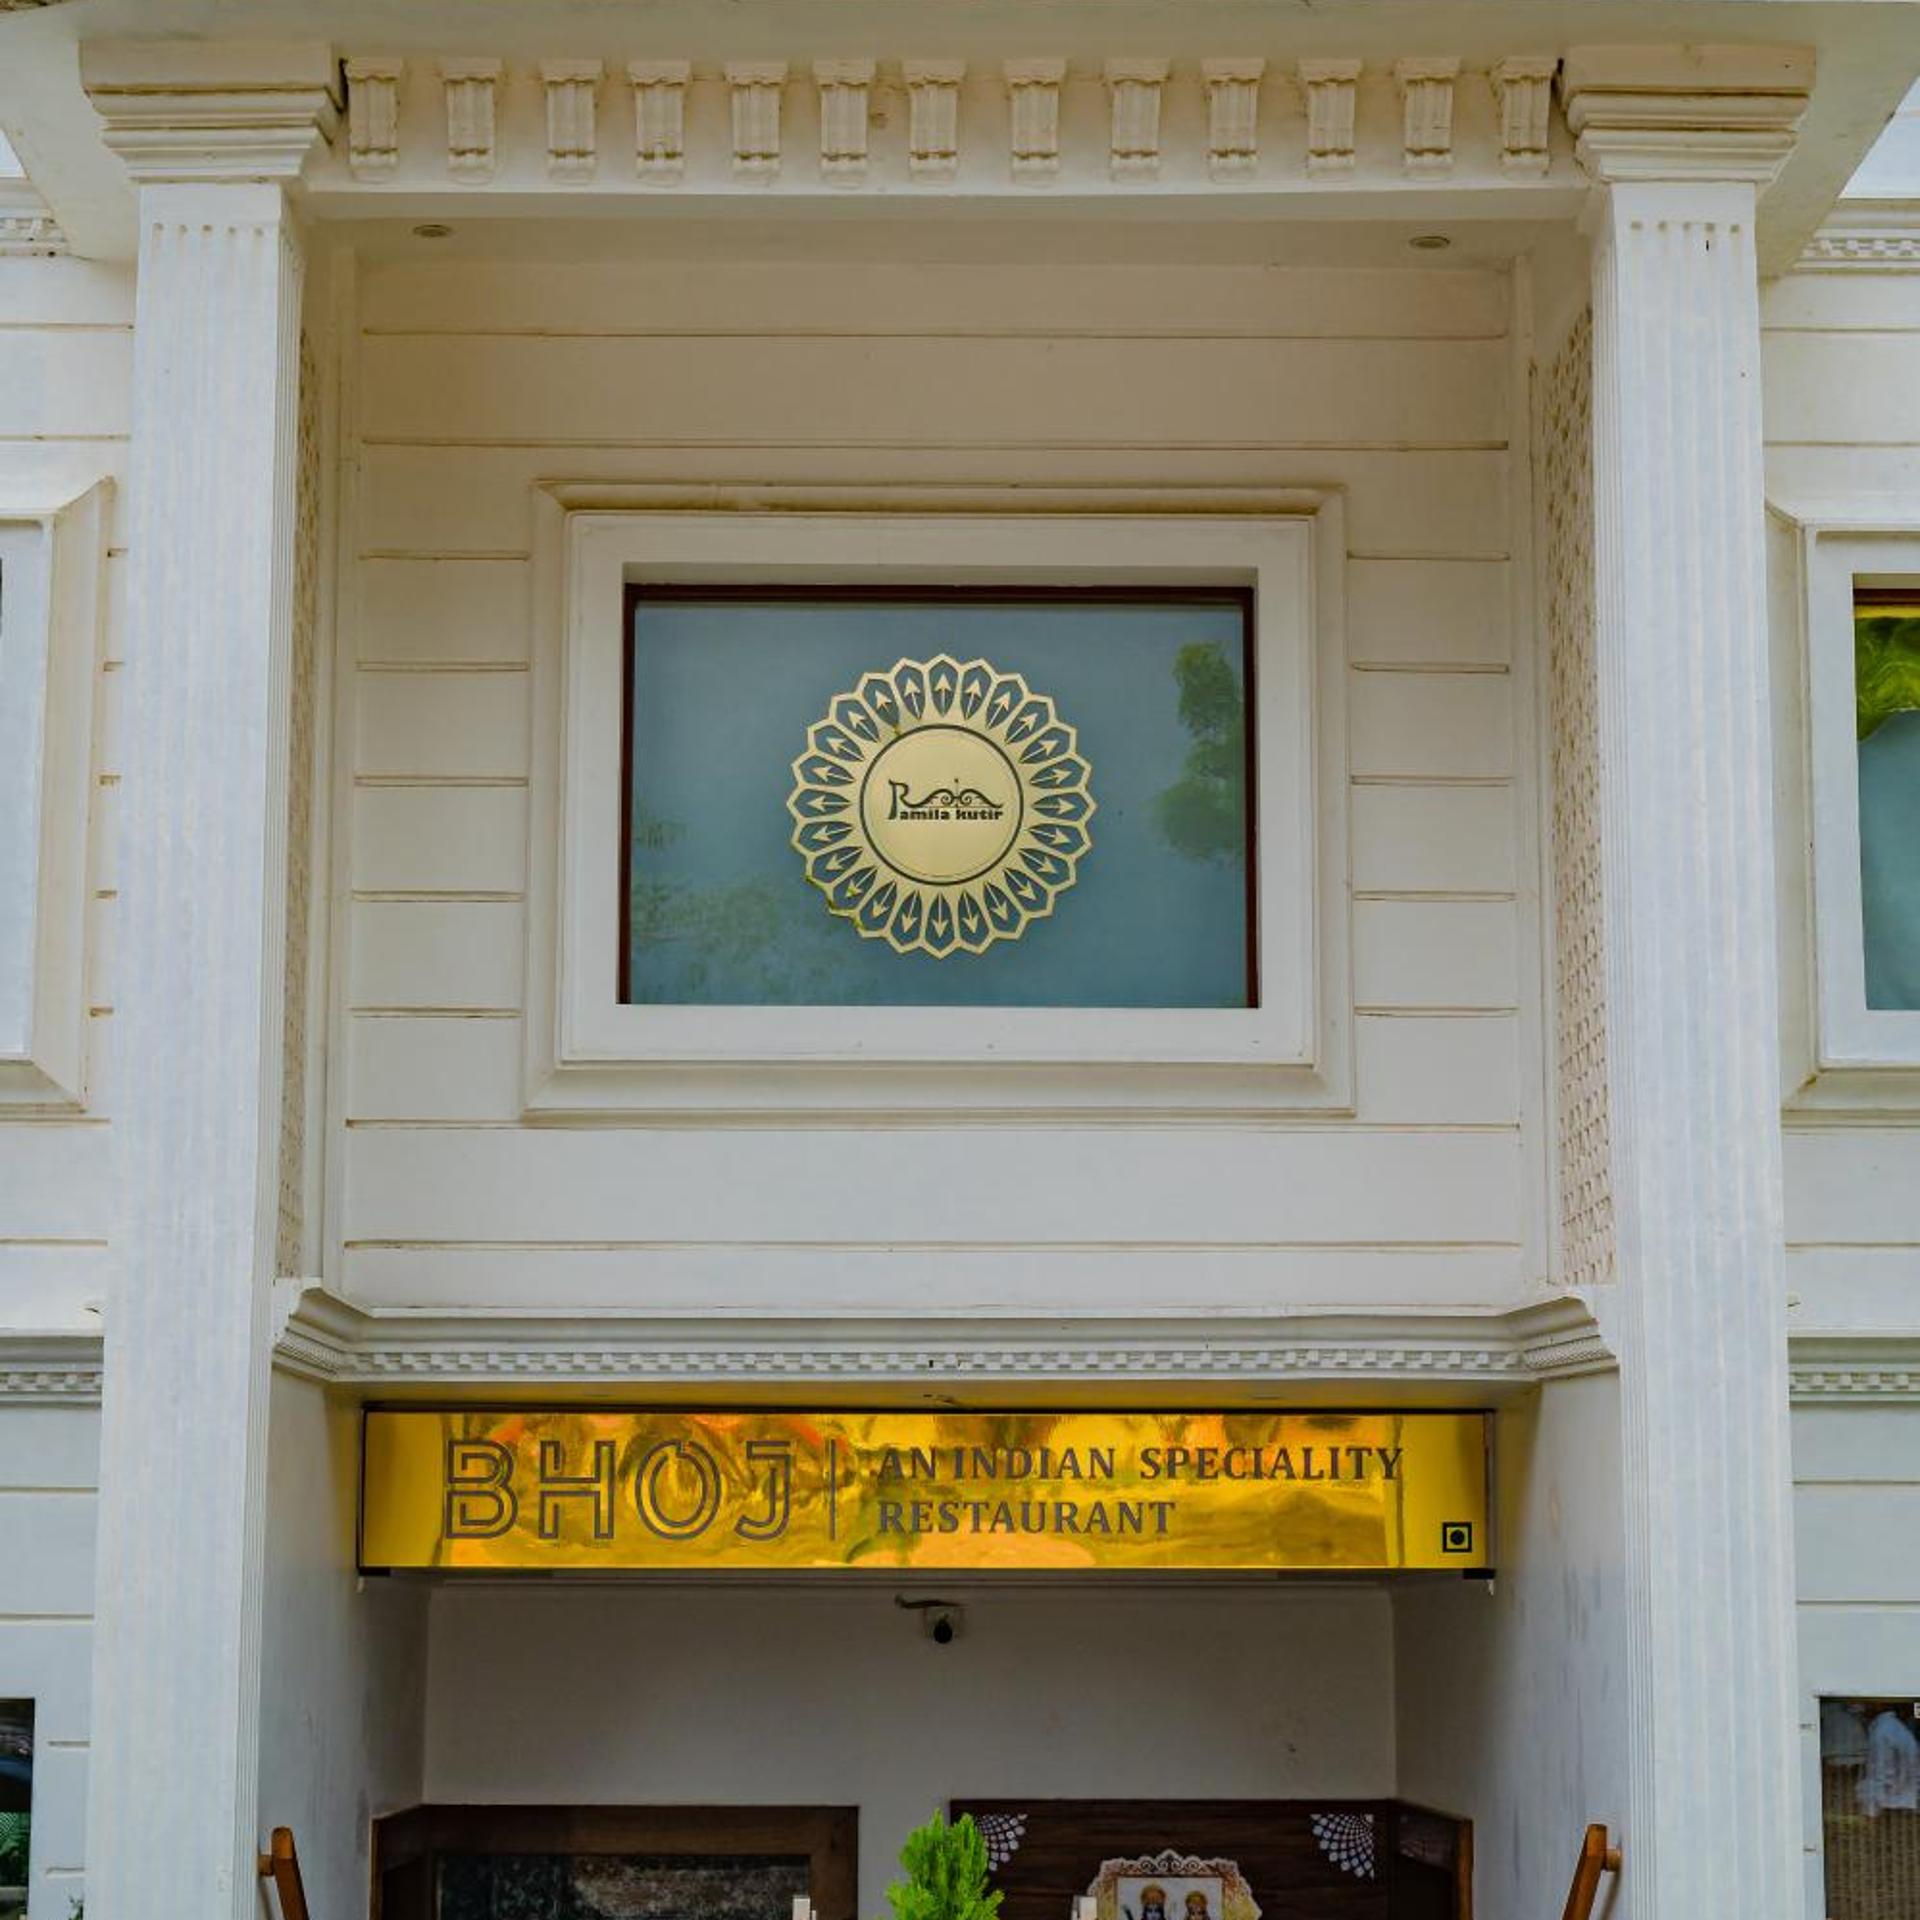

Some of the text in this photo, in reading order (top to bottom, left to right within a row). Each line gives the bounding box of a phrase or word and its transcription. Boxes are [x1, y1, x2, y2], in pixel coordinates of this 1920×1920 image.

[877, 1446, 1404, 1481] AN INDIAN SPECIALITY
[446, 1440, 793, 1541] BHOJ
[877, 1500, 1176, 1535] RESTAURANT
